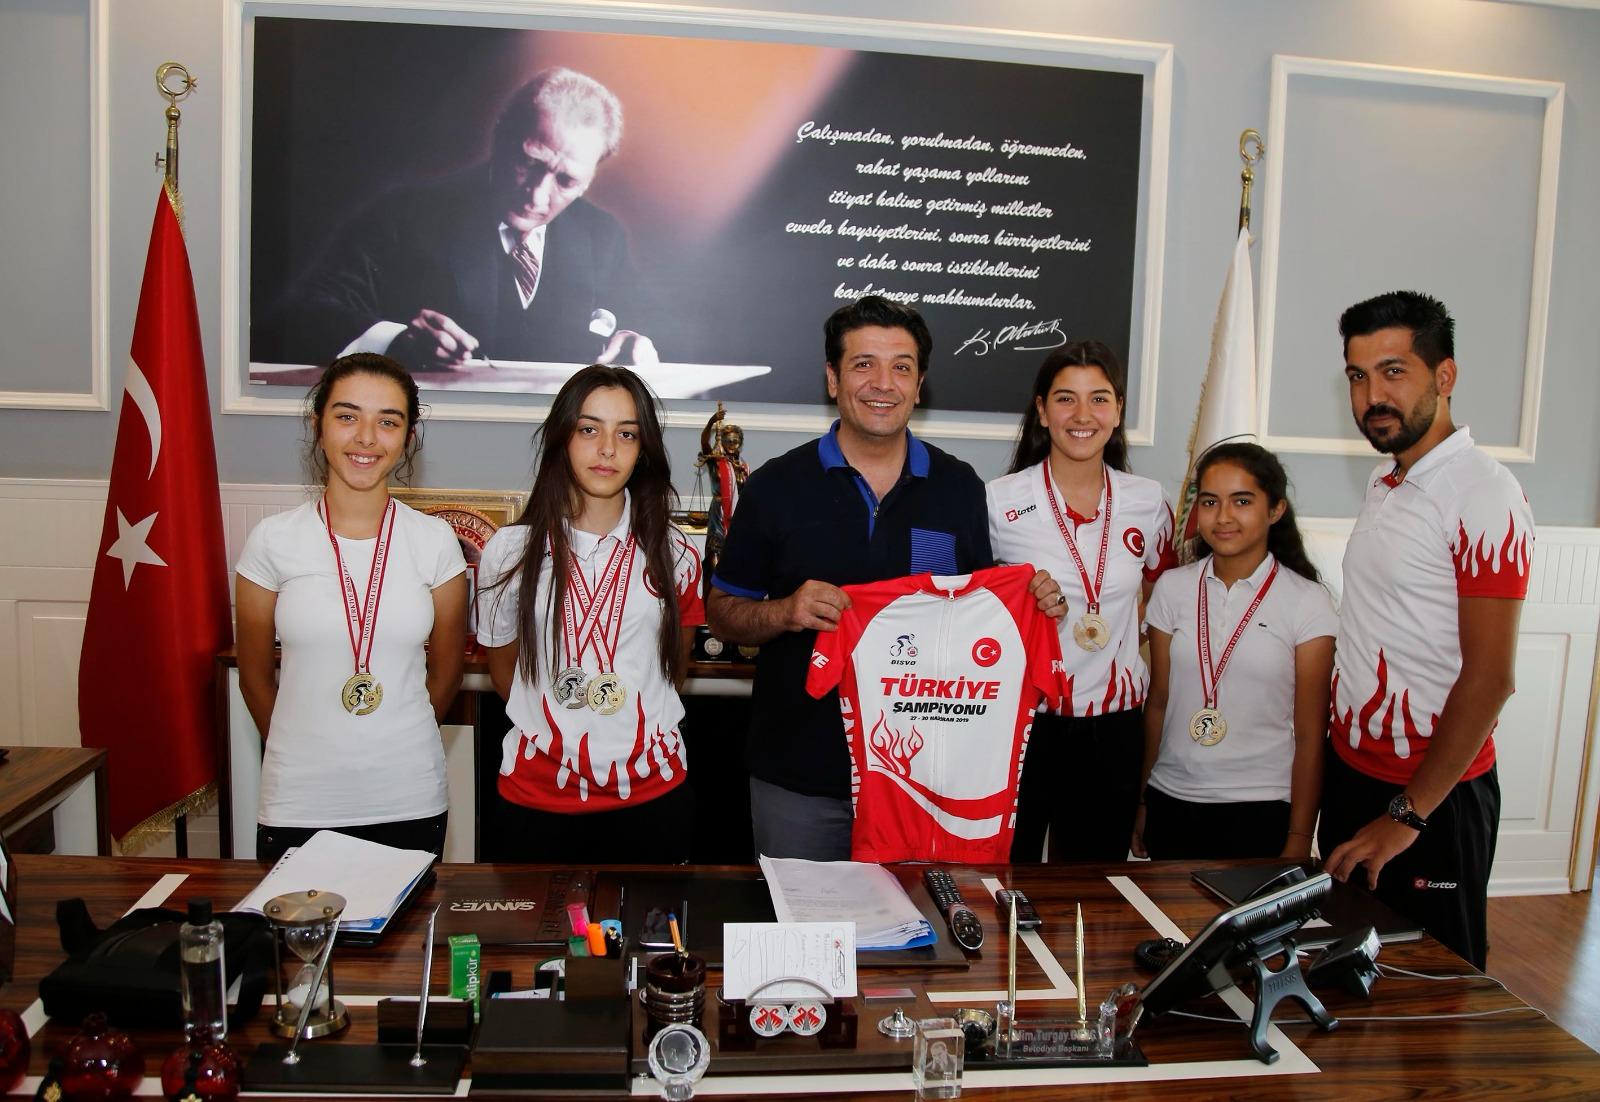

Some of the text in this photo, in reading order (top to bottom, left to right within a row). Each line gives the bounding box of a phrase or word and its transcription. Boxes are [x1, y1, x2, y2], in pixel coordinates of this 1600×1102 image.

[797, 121, 1087, 160] Çalışmadan, yorulmadan, öğrenmeden,
[856, 159, 1030, 185] rahat yaşama yollarını
[829, 191, 1053, 218] itiyat haline getirmiş milletler
[786, 220, 1090, 252] evvela haysiyetlerini, sonra hürriyetlerini
[837, 253, 1039, 279] ve daha sonra istiklallerini
[923, 288, 1036, 310] mahkumdurlar.
[880, 673, 1001, 700] TÜRKİYE
[450, 901, 536, 912] SANVER
